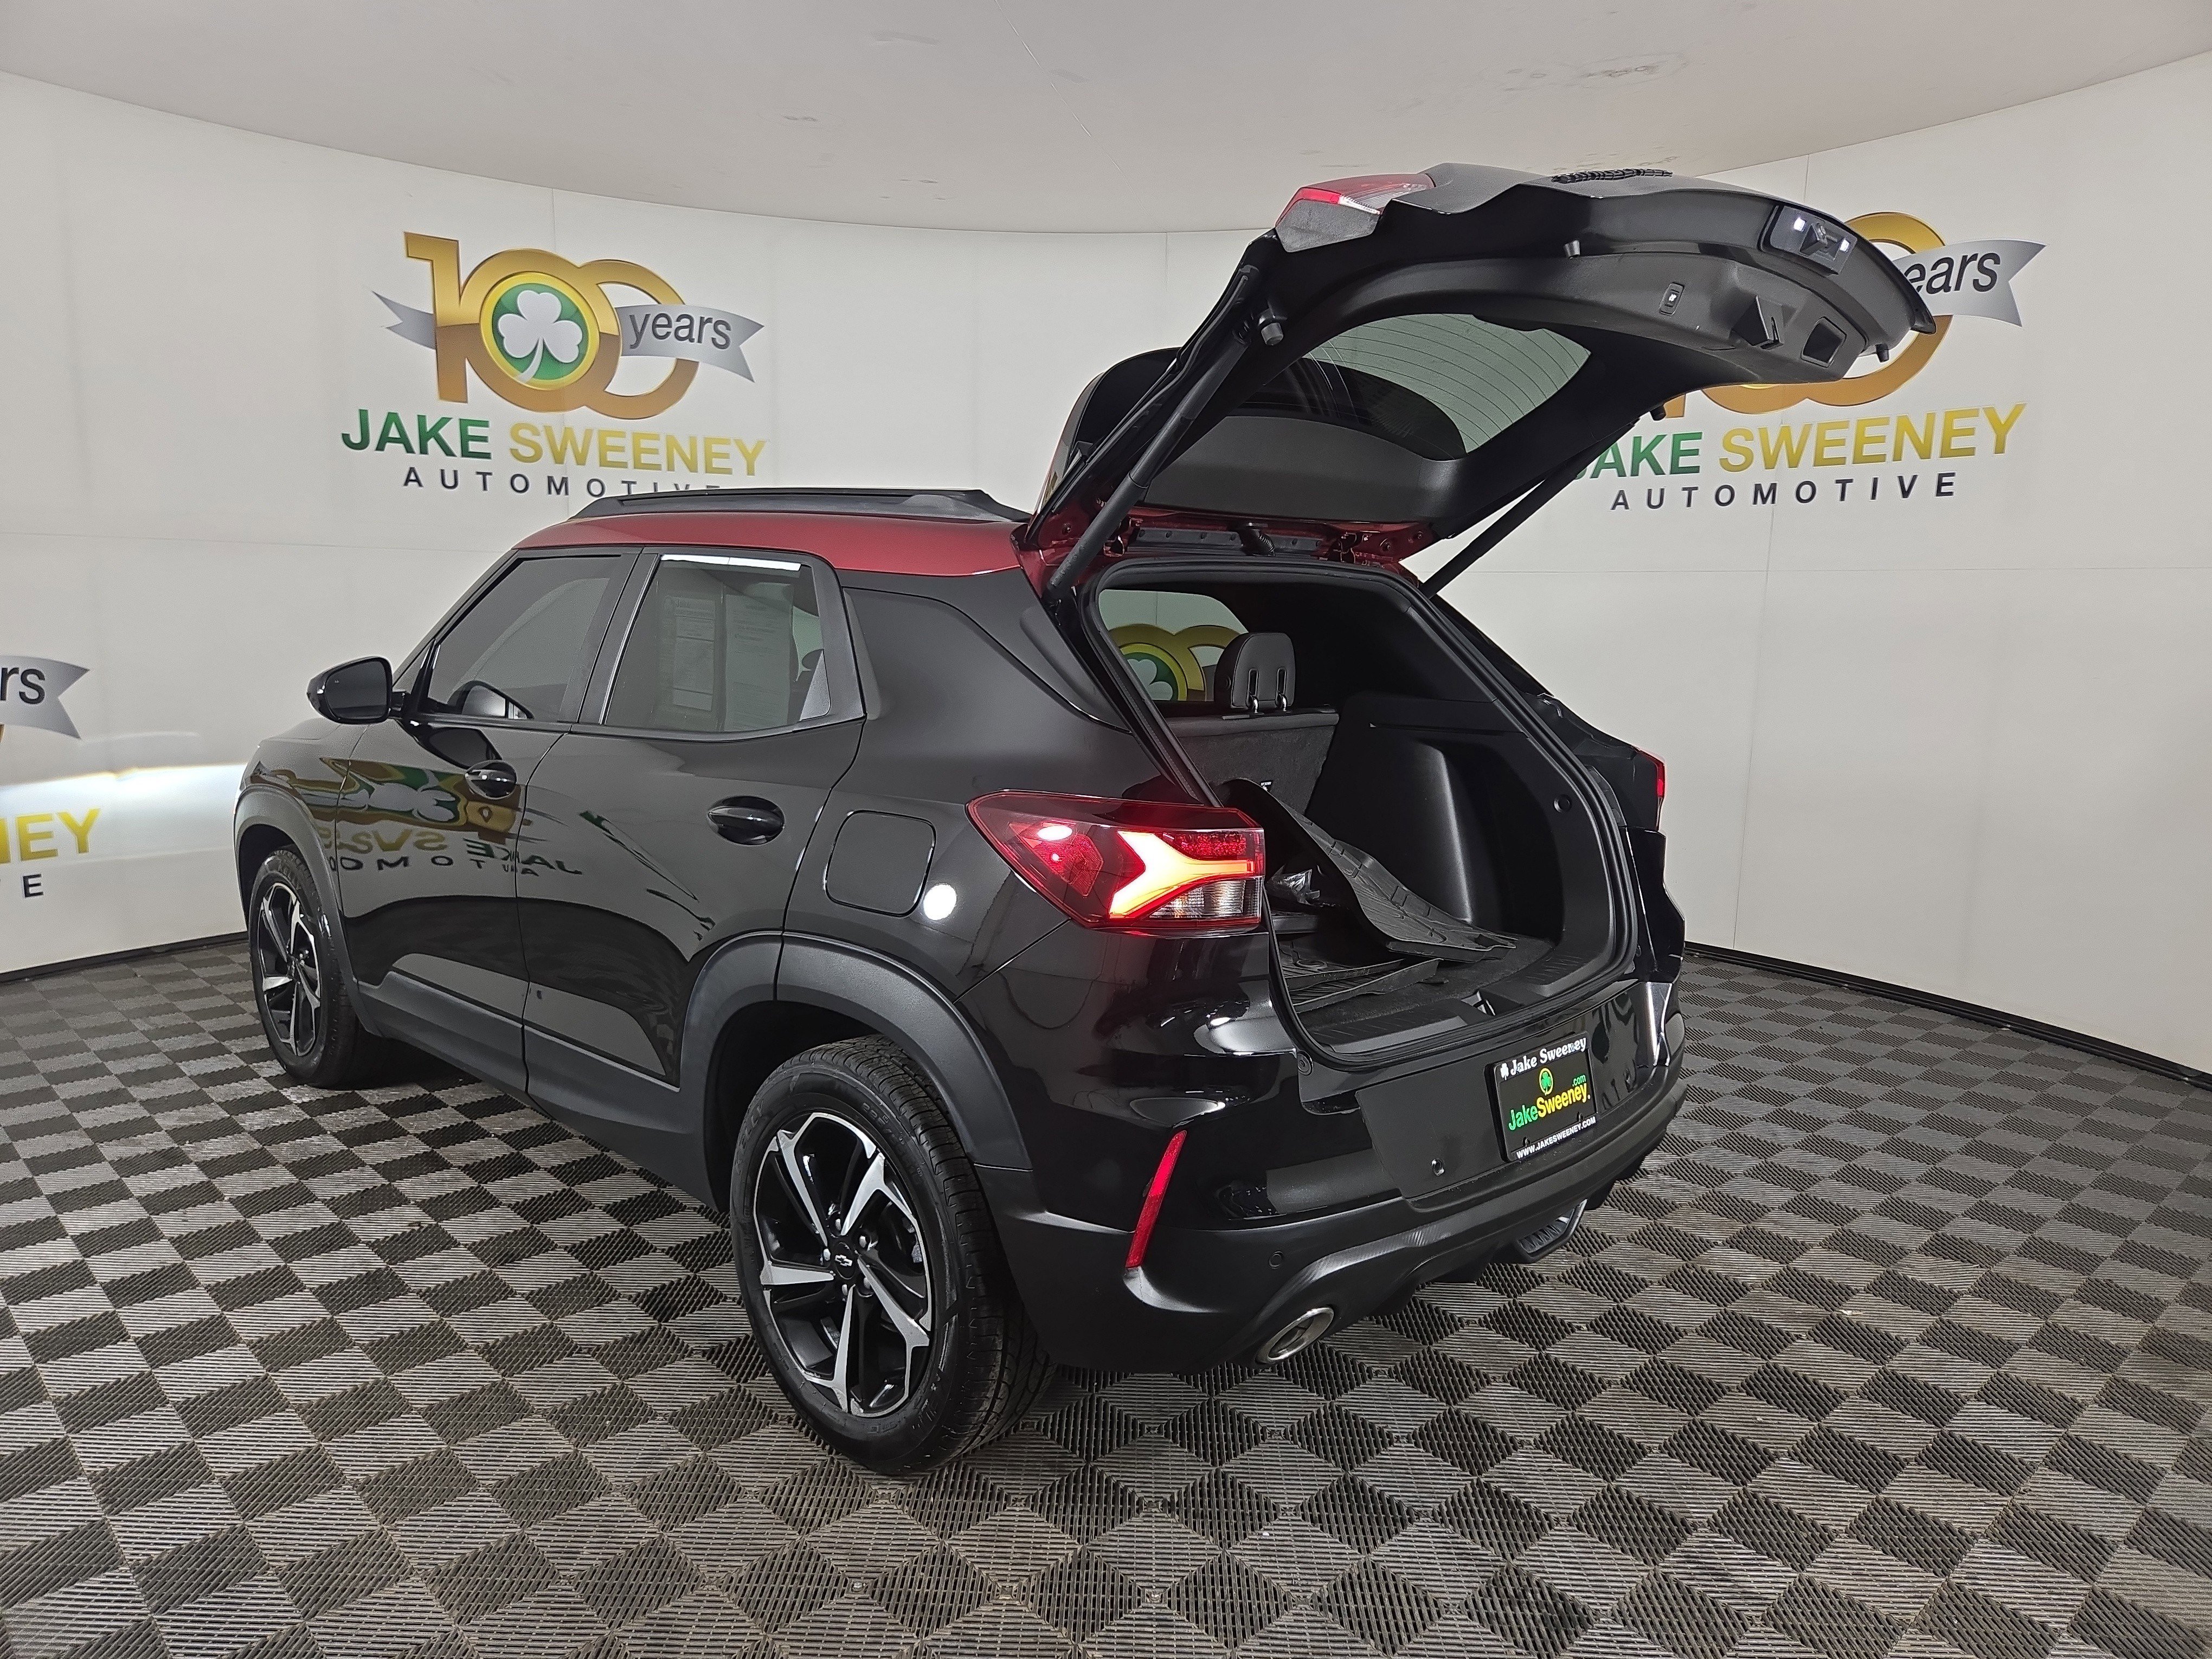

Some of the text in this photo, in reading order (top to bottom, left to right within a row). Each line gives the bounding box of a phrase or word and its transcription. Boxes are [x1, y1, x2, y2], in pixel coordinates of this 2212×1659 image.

[1904, 252, 2001, 294] ears
[629, 312, 731, 350] years
[342, 409, 767, 476] JAKE SWEENEY
[1575, 403, 2027, 480] AKE SWEENEY
[403, 467, 721, 498] AUTOMOT
[1610, 472, 1956, 511] AUTOMOTIVE
[0, 808, 100, 864] EY
[1510, 1037, 1586, 1076] Jake Sweeney
[1572, 1074, 1586, 1087] .com
[1516, 1116, 1596, 1159] WWW.JAKESWEENEY.COM
